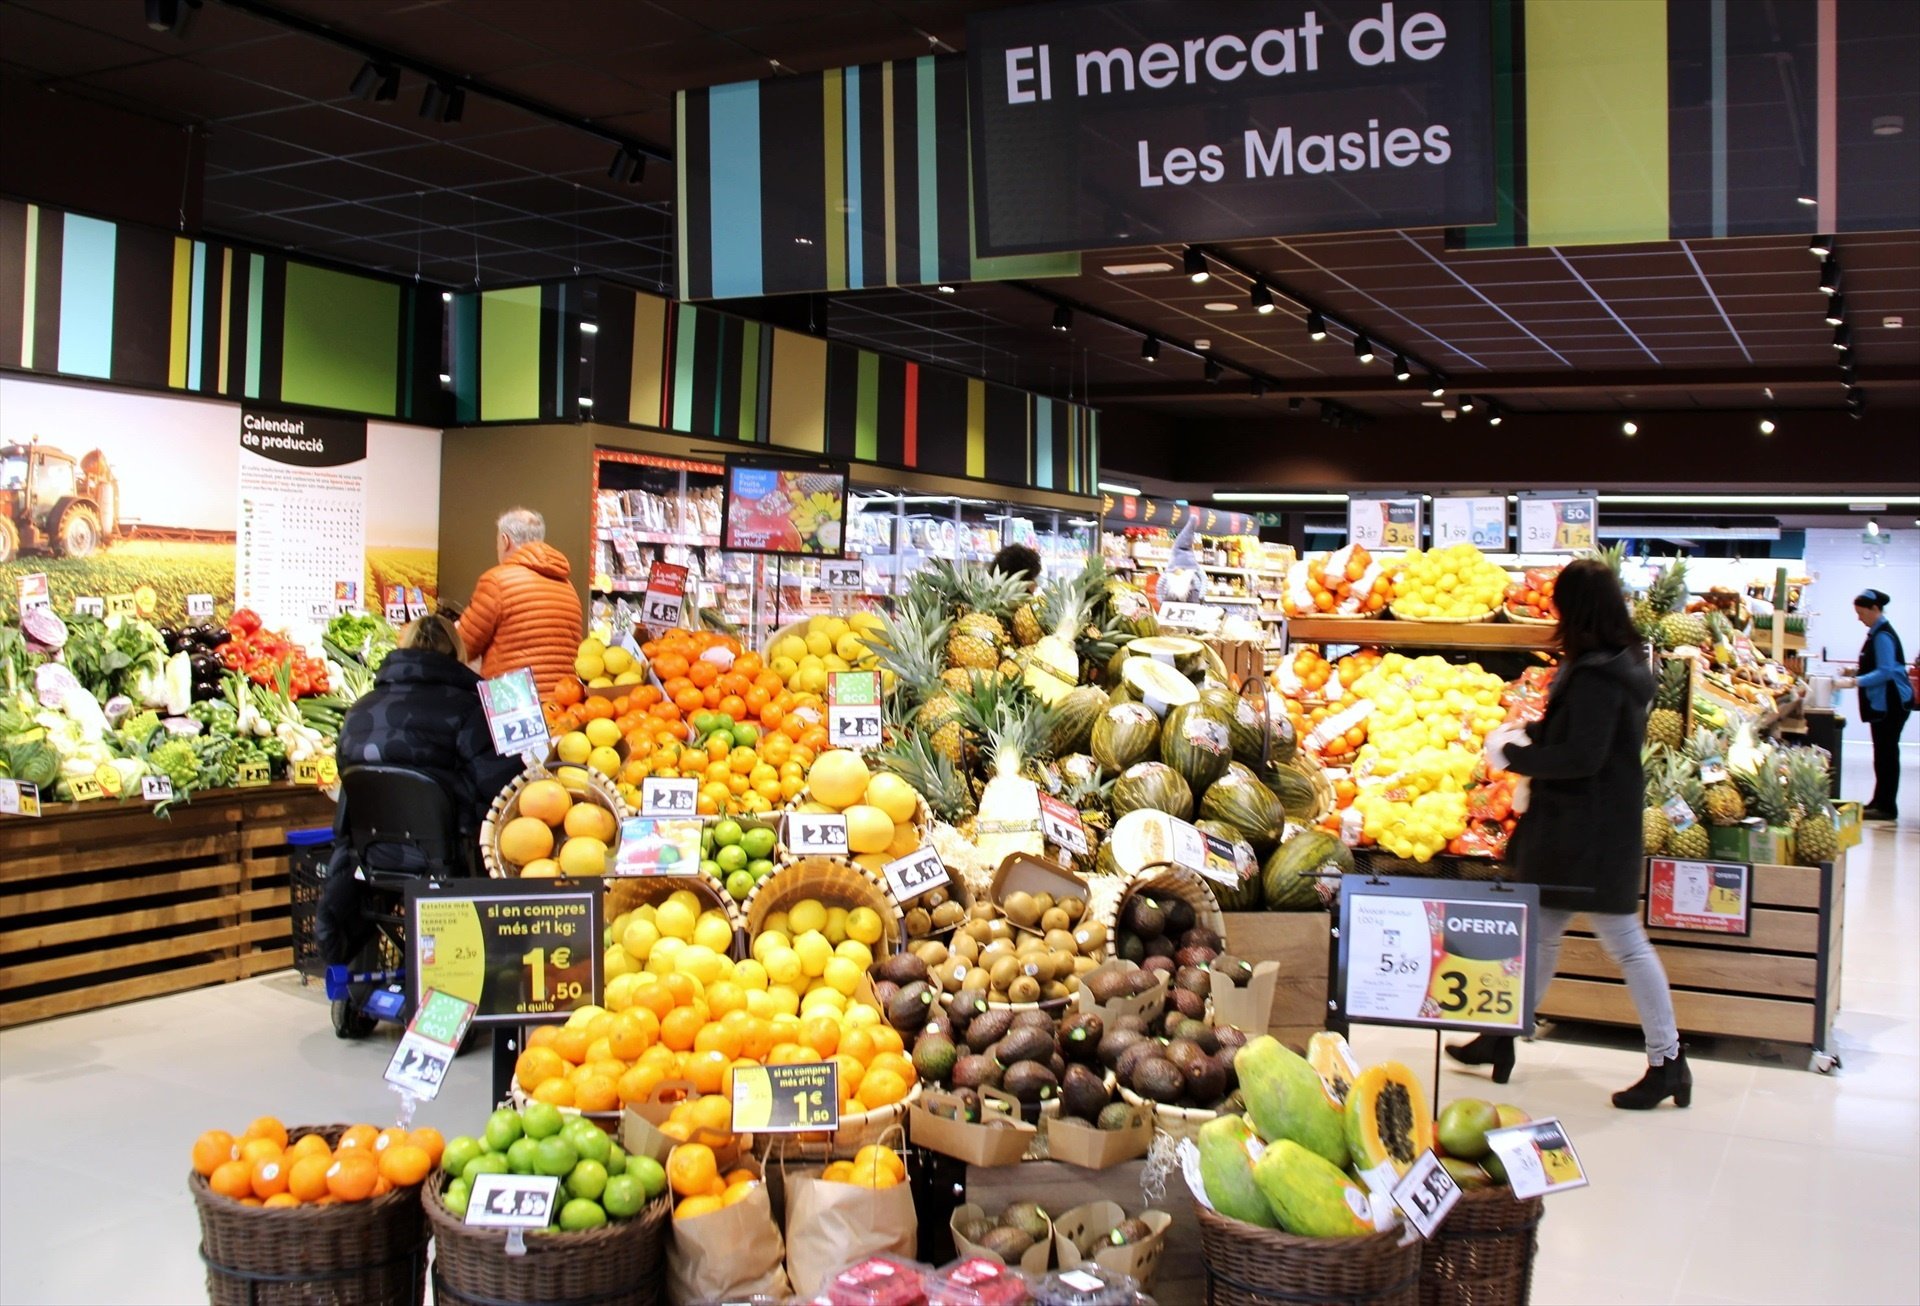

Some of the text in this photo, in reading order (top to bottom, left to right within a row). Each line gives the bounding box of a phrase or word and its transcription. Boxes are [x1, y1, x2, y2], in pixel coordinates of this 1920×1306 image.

[1005, 2, 1448, 104] El mercat de
[1138, 119, 1452, 187] Les Masies
[243, 414, 304, 435] Calendari
[242, 431, 324, 453] de producció
[843, 693, 867, 703] eco
[488, 904, 586, 919] si en compres
[498, 921, 576, 937] més d'1 kg:
[1447, 917, 1519, 936] OFERTA
[1380, 953, 1419, 975] 5,69
[1439, 971, 1513, 1017] 3,25
[516, 1001, 554, 1013] el quilo
[422, 1019, 447, 1040] eco
[782, 1068, 794, 1077] en
[794, 1065, 831, 1078] compres
[780, 1078, 798, 1088] més
